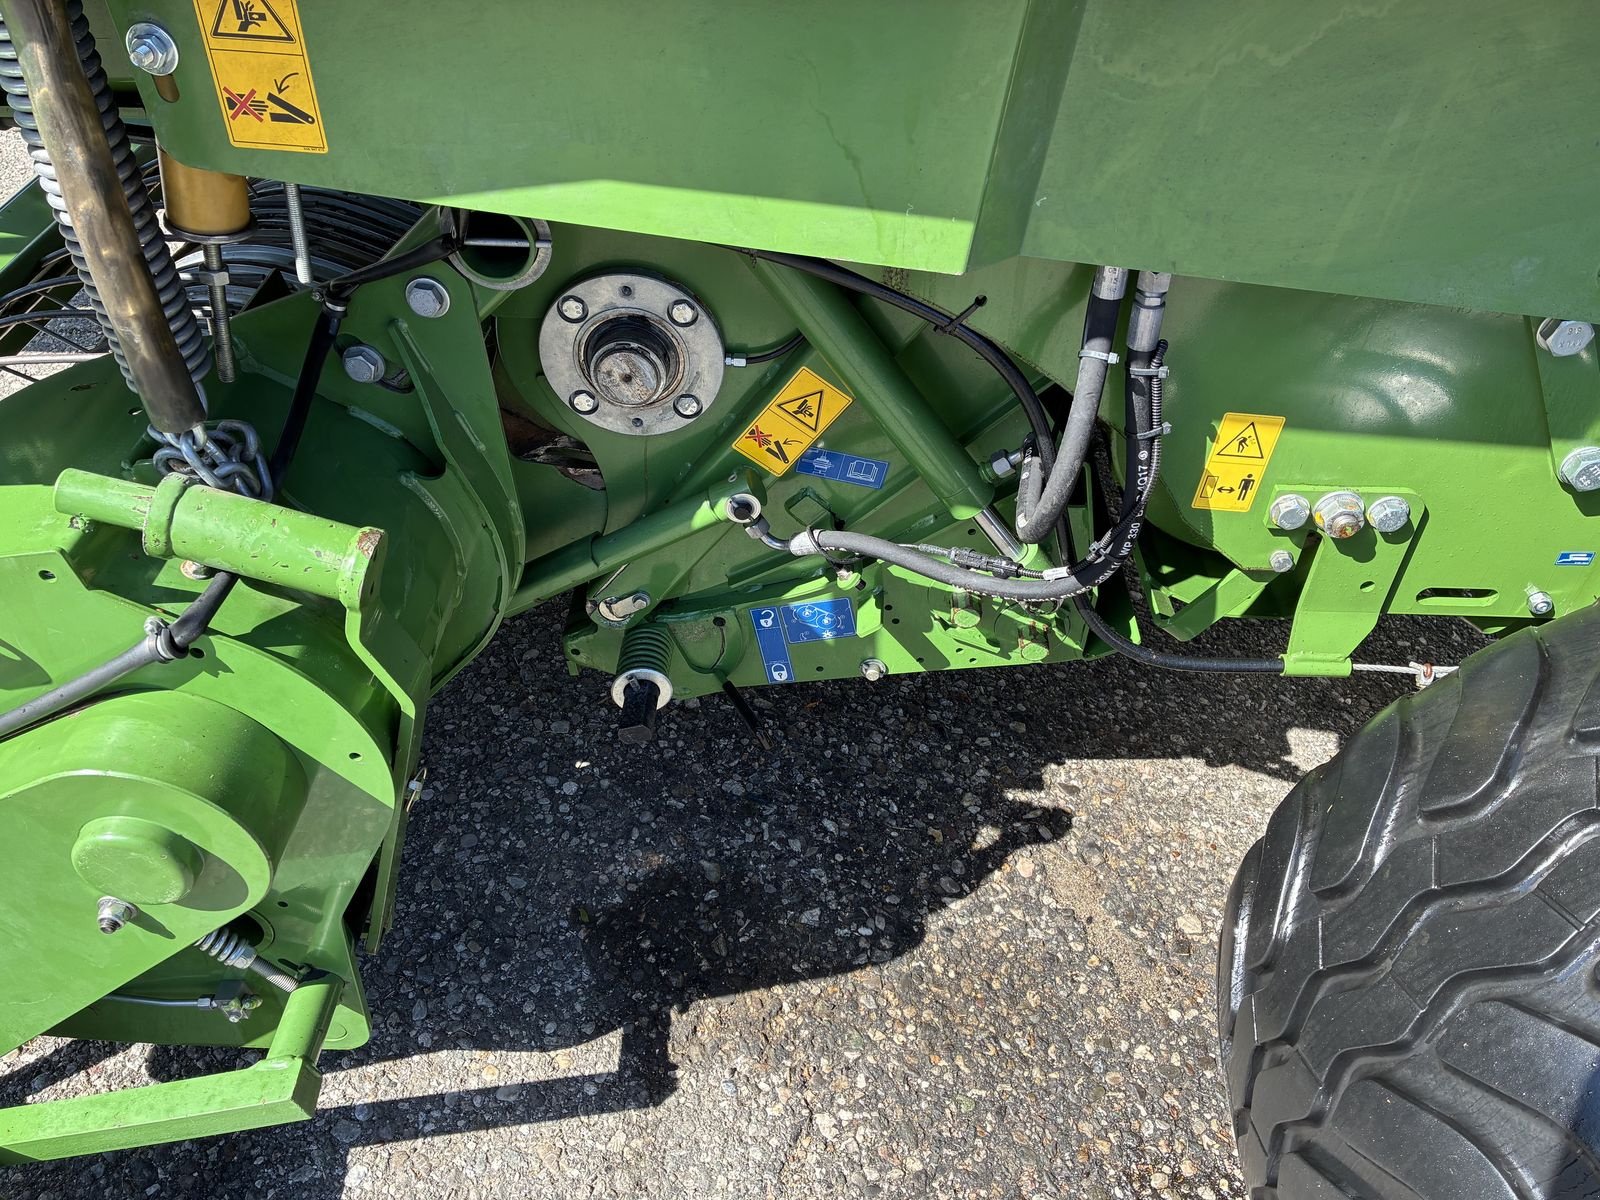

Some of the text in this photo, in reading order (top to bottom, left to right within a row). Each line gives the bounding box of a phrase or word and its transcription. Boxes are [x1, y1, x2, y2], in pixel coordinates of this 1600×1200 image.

[1118, 541, 1133, 556] WP
[1127, 522, 1141, 540] 330
[1137, 465, 1149, 491] 4Q17
